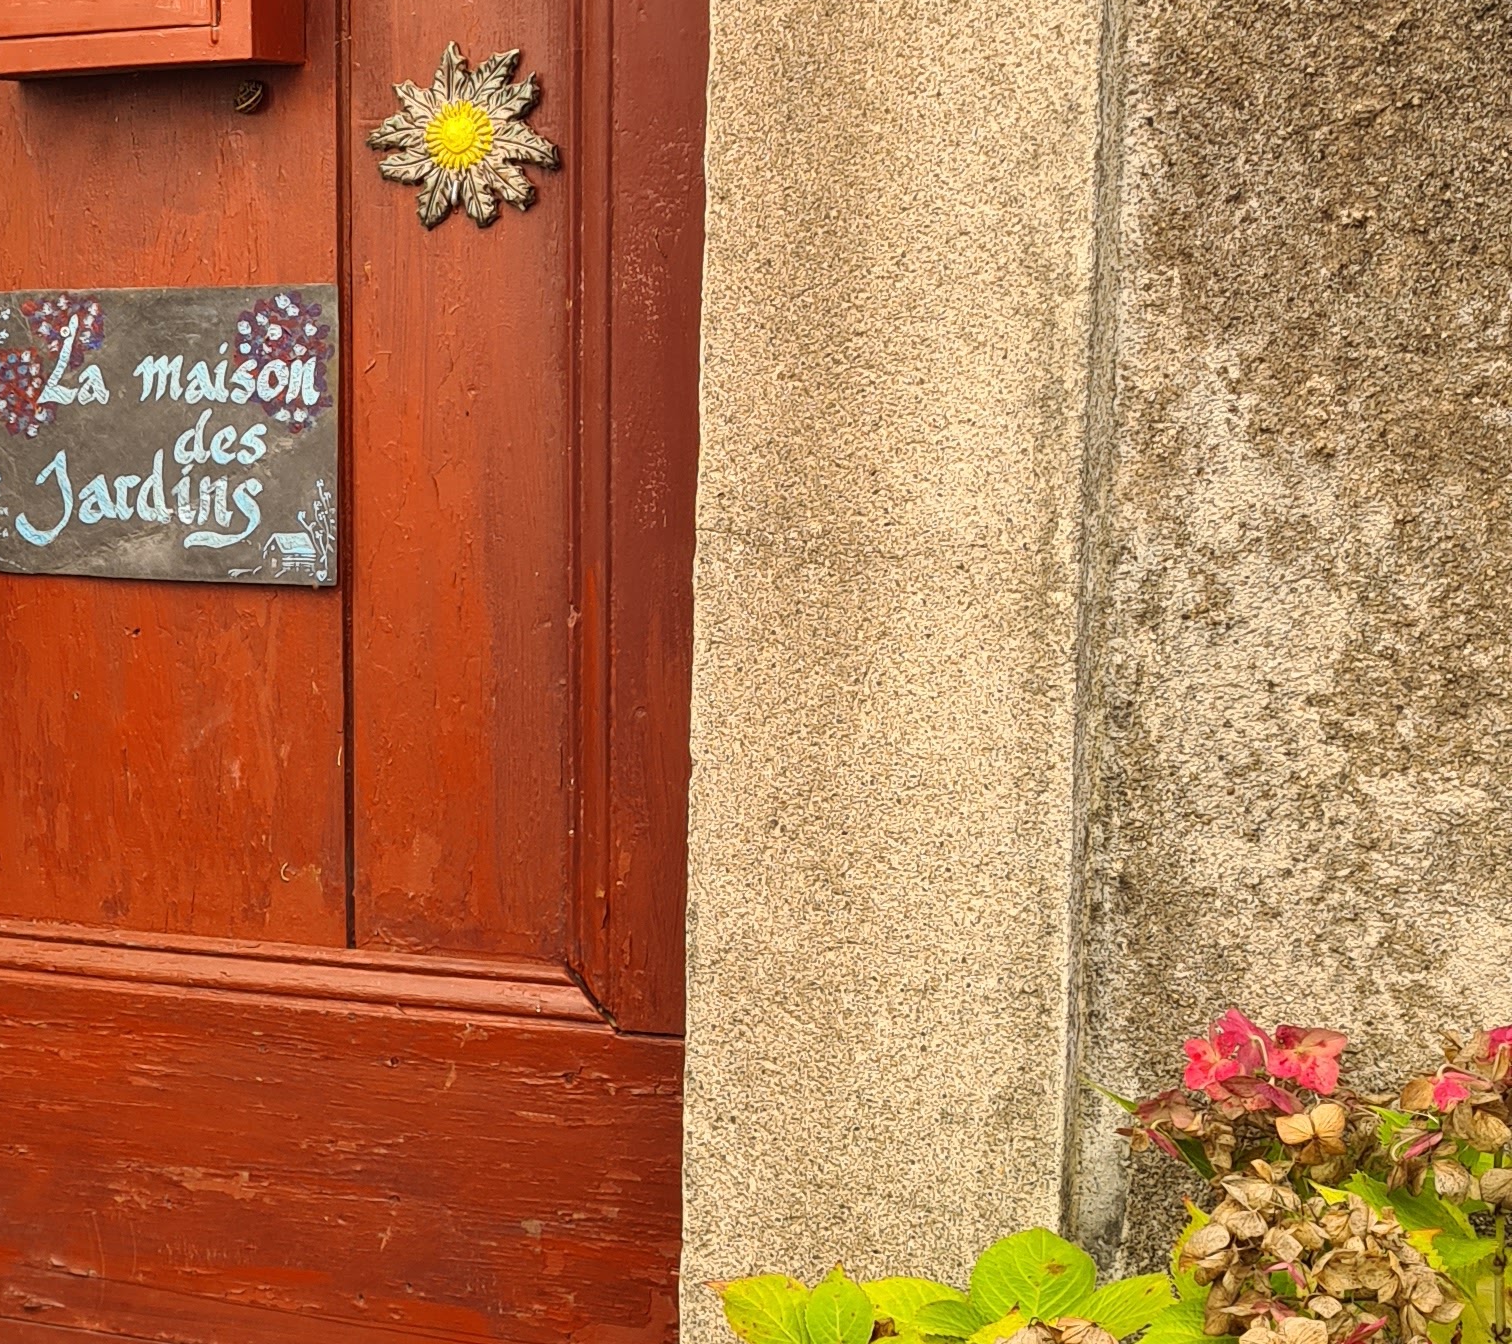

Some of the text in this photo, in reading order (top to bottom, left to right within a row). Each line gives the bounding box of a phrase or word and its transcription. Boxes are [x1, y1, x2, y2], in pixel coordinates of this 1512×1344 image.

[36, 313, 321, 407] La maison
[173, 408, 268, 466] des
[14, 448, 264, 550] Jardins
